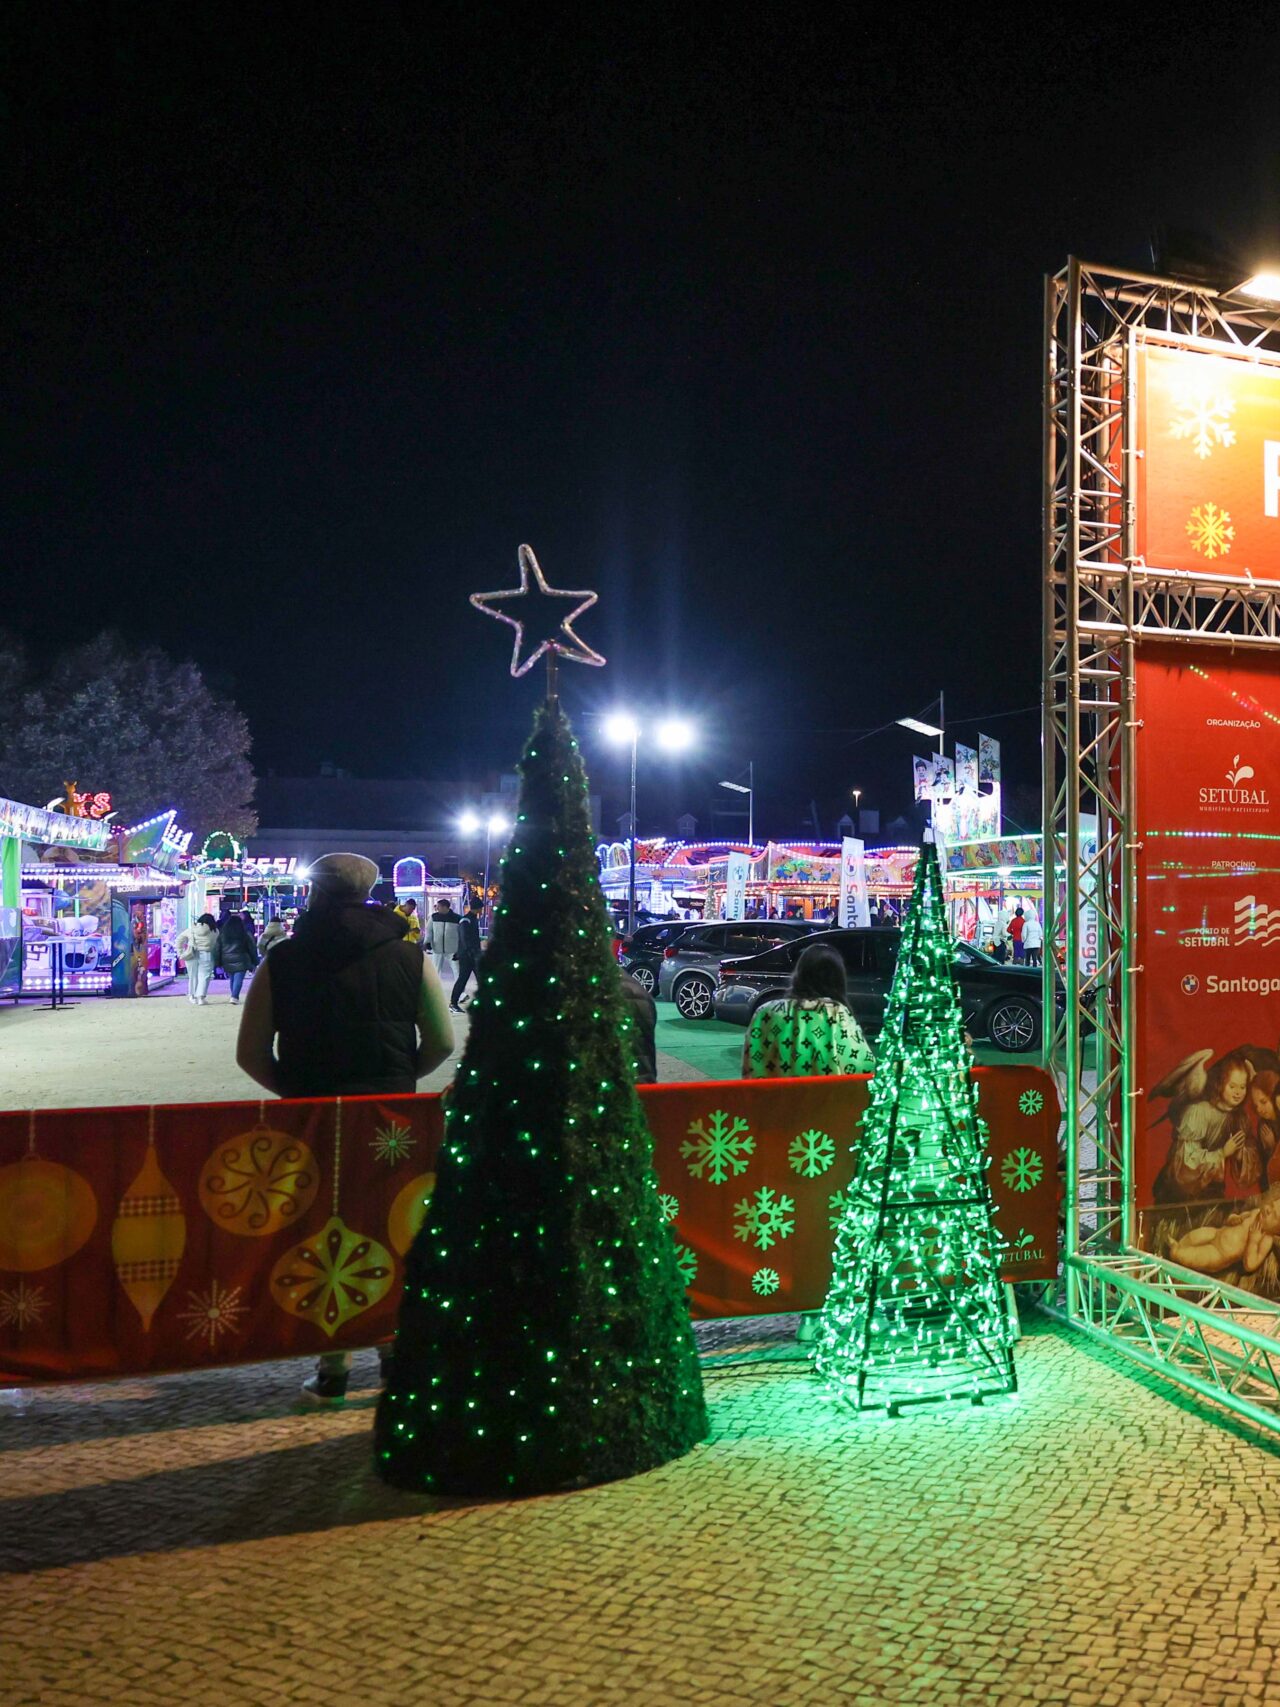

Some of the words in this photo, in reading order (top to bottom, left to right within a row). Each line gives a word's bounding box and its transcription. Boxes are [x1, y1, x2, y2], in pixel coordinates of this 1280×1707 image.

[1206, 718, 1261, 730] ORGANIZAÇÃO
[1211, 860, 1257, 869] PATROCÍNIO
[733, 889, 742, 920] Sant
[847, 884, 857, 928] Santo
[1195, 927, 1219, 935] PORTO
